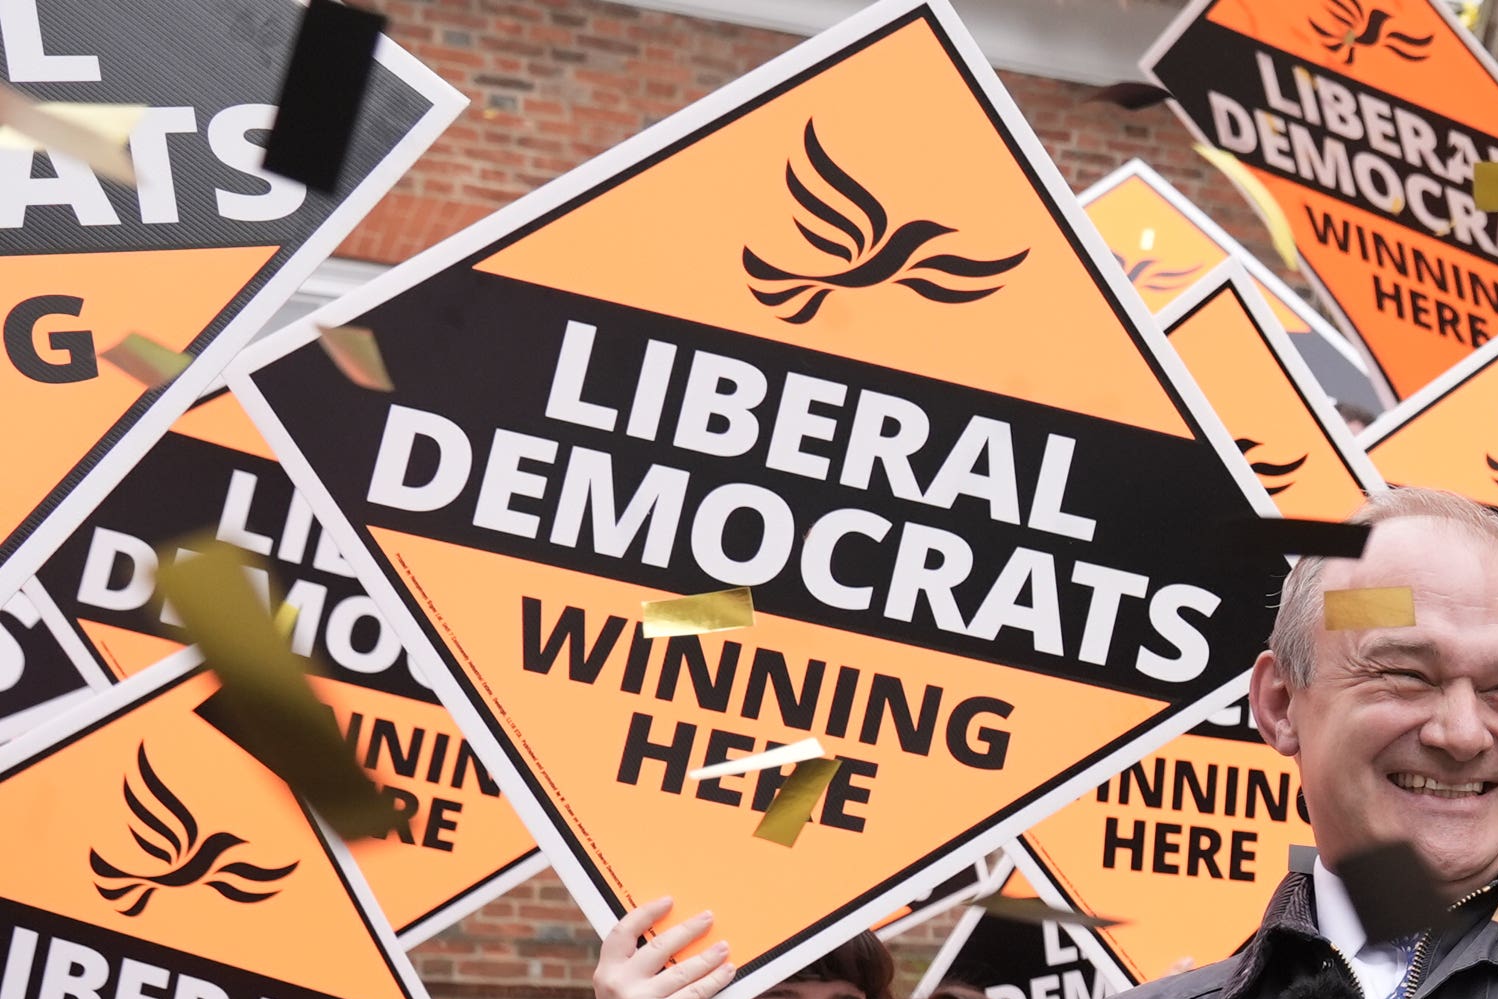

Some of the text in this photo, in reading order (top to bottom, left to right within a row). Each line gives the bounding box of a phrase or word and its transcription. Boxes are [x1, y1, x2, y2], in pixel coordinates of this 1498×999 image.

[544, 320, 1097, 541] LIBERAL
[366, 404, 1222, 682] DEMOCRATS
[521, 595, 1015, 770] WINNING
[1102, 817, 1258, 882] HERE
